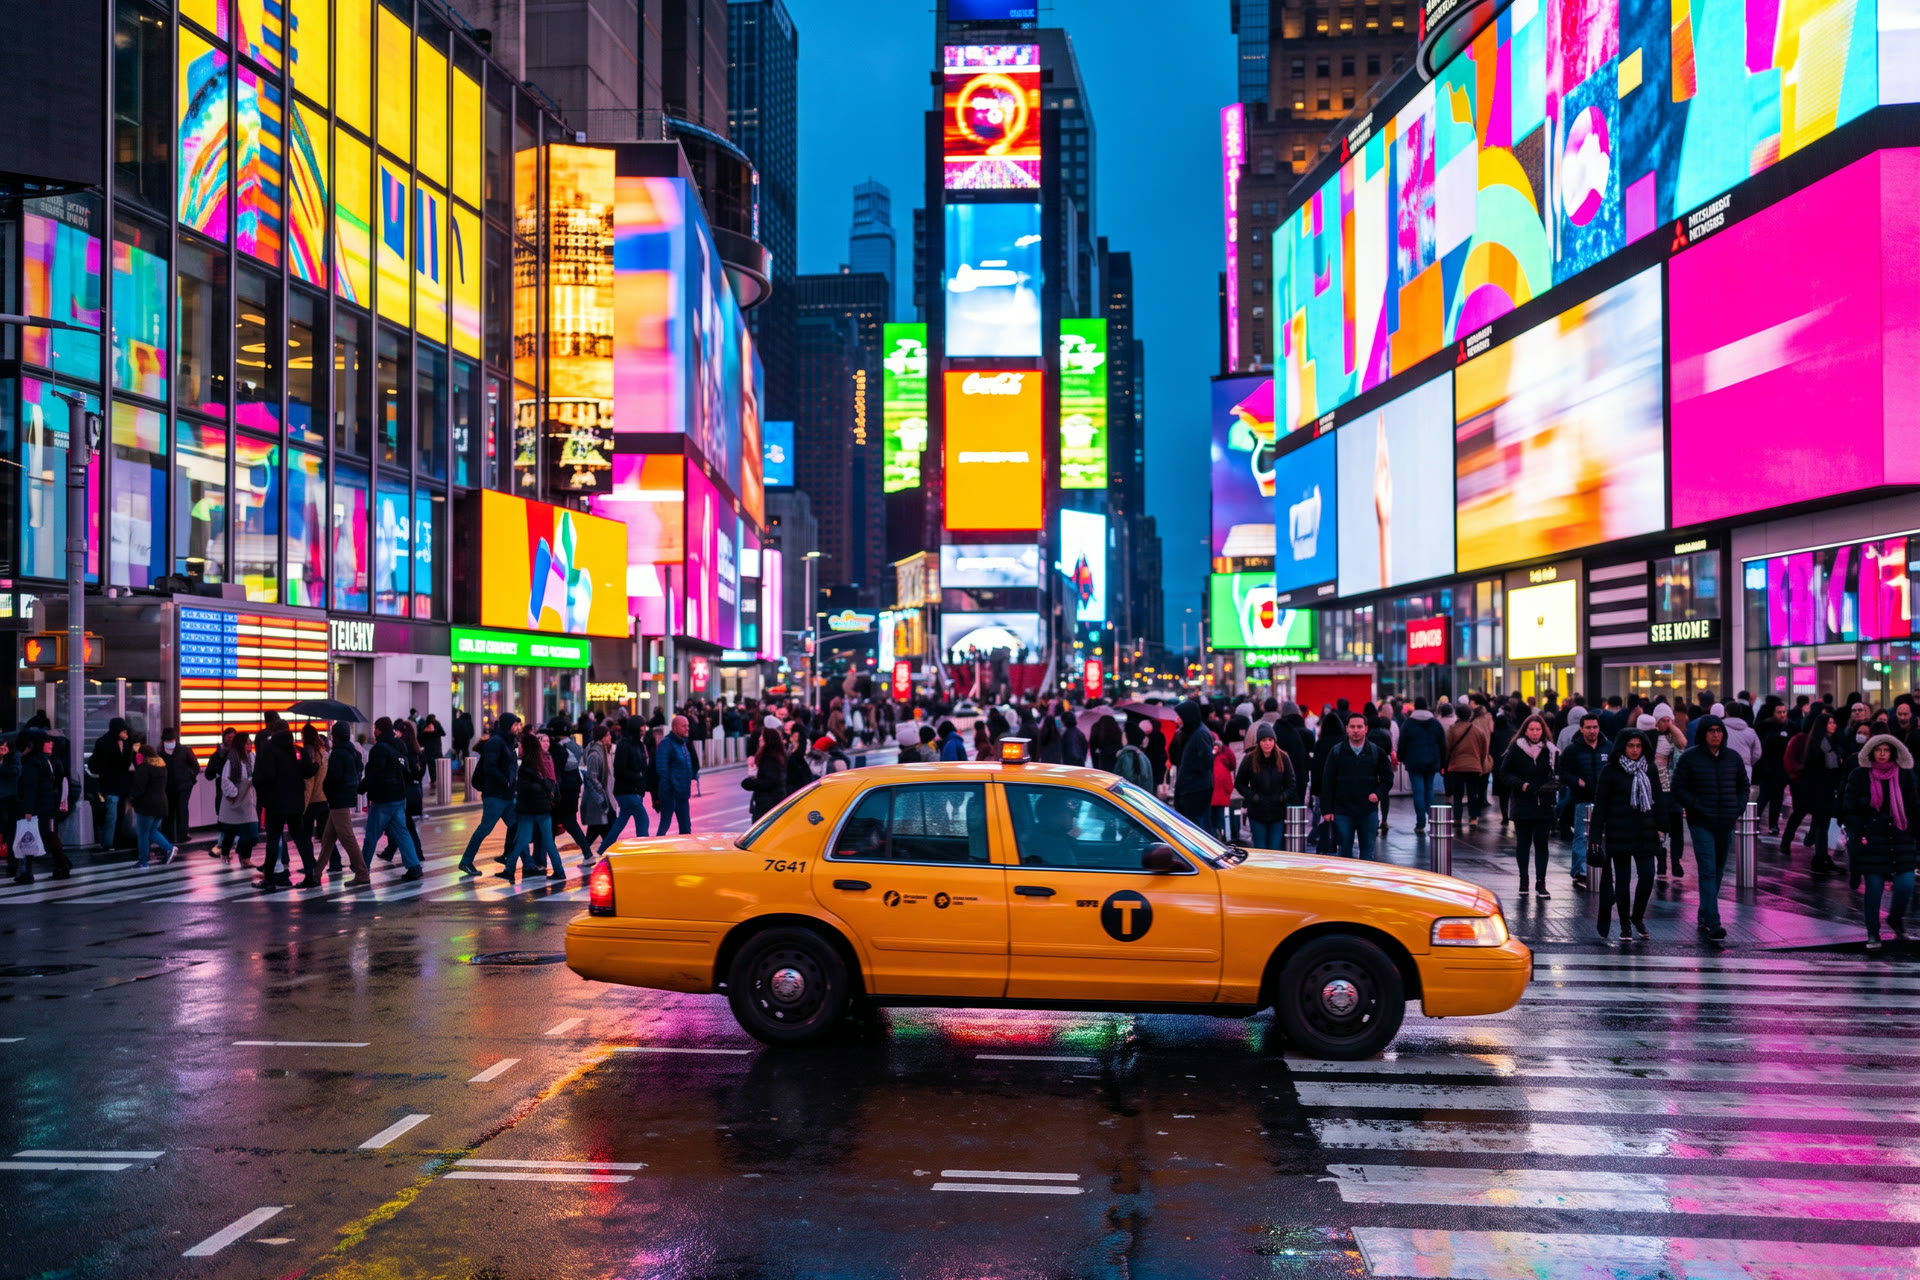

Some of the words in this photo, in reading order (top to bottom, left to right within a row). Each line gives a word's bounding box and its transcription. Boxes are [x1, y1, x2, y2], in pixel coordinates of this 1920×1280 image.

[1651, 623, 1673, 642] SEE
[1673, 620, 1710, 641] KONE
[764, 859, 807, 873] 7G41
[1112, 900, 1142, 935] T
